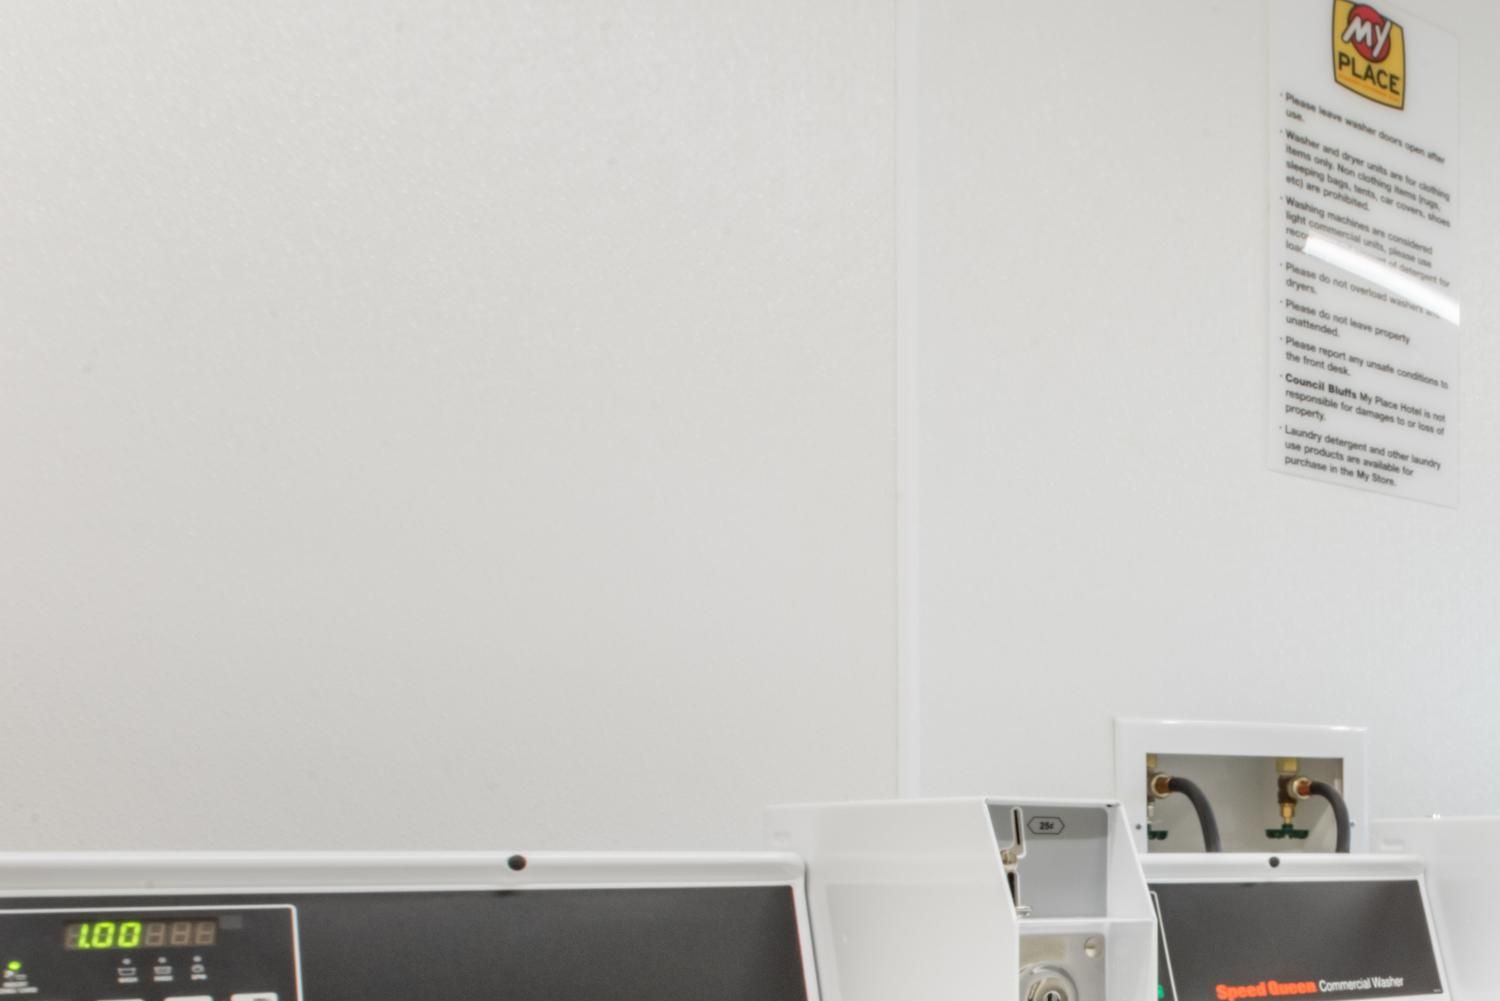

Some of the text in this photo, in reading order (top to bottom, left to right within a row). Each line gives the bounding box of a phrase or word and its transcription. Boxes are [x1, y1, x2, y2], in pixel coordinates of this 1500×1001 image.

[1339, 52, 1400, 95] PLACE
[1286, 110, 1305, 122] use.
[1286, 93, 1445, 164] Please leave washer doors open after
[1286, 130, 1450, 202] Washer and dryer units are for clothing
[1286, 146, 1311, 162] items
[1314, 156, 1335, 171] only.
[1337, 164, 1355, 177] Non
[1357, 172, 1392, 193] clothing
[1394, 185, 1416, 201] items
[1286, 160, 1451, 228] sleeping bags, tents, car covers, shoes
[1306, 183, 1320, 194] are
[1323, 187, 1370, 212] prohibited.
[1286, 197, 1324, 219] Washing
[1327, 210, 1370, 233] machines
[1372, 223, 1385, 239] are
[1387, 230, 1433, 255] considered
[1286, 212, 1306, 226] light
[1363, 238, 1386, 254] units,
[1389, 248, 1416, 263] please
[1417, 256, 1432, 268] use
[1286, 279, 1317, 294] dryers.
[1286, 263, 1316, 280] Please
[1319, 272, 1330, 284] do
[1333, 279, 1347, 290] not
[1350, 285, 1387, 302] overload
[1390, 296, 1423, 314] washers
[1399, 265, 1437, 284] detergent
[1440, 277, 1450, 287] for
[1286, 300, 1410, 345] Please do not leave property
[1286, 316, 1340, 337] unattended.
[1286, 337, 1448, 390] Please report any unsafe conditions to
[1286, 352, 1351, 376] the front desk.
[1286, 374, 1446, 422] Council Bluffs My Place Hotel is not
[1286, 389, 1338, 409] responsible
[1341, 402, 1353, 413] for
[1355, 407, 1395, 423] damages
[1397, 415, 1405, 426] to
[1407, 419, 1416, 428] or
[1418, 421, 1434, 434] loss
[1286, 405, 1326, 421] property.
[1285, 425, 1441, 471] Laundry detergent and other laundry
[1285, 442, 1414, 476] use products are available for
[1285, 456, 1397, 486] purchase in the My Store.
[1216, 975, 1404, 1001] Speed Queen Commercial Washer
